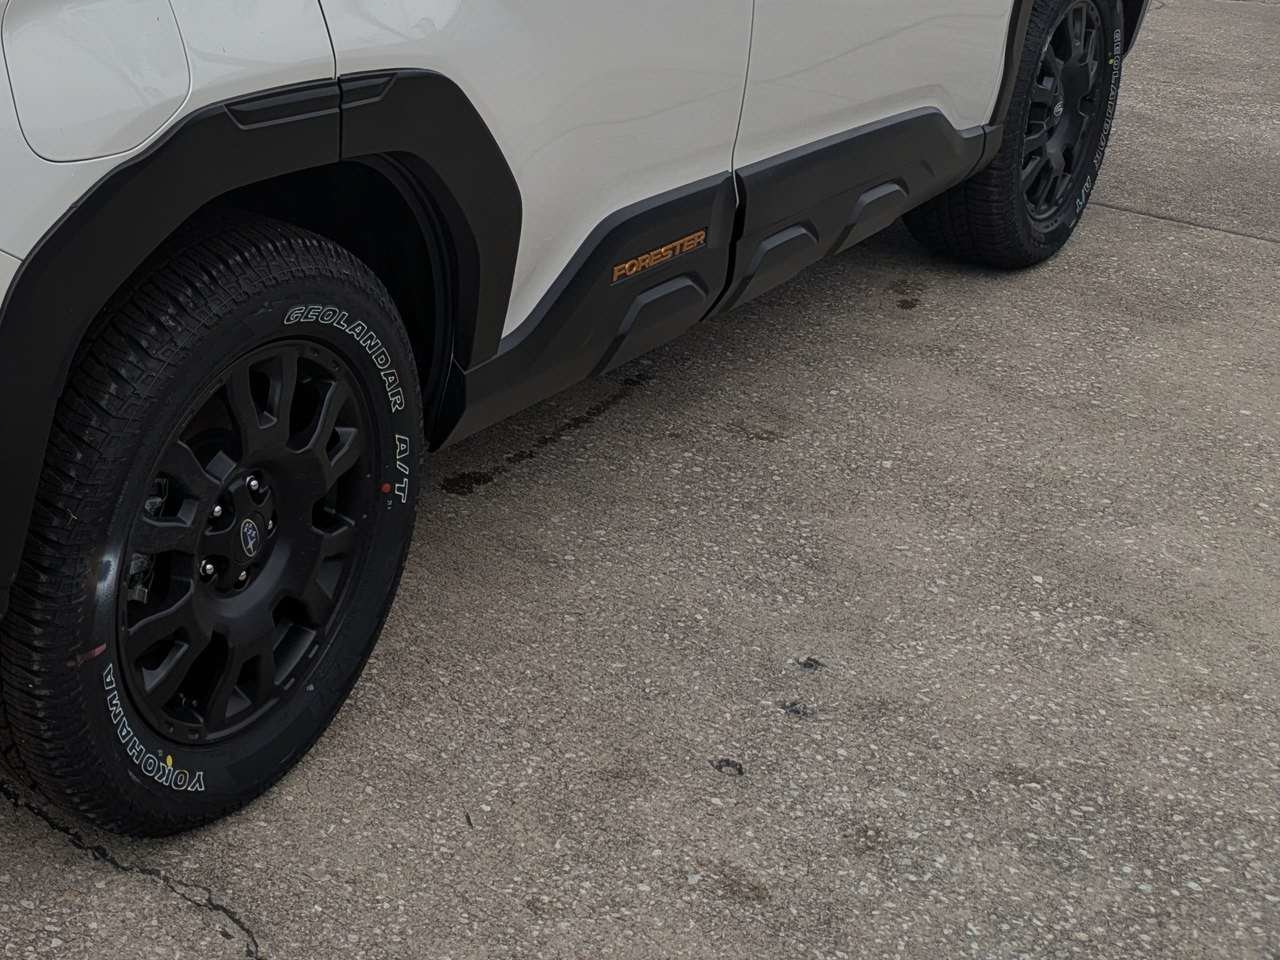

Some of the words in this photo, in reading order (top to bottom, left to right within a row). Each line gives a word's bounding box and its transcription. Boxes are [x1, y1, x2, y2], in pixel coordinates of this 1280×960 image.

[611, 229, 706, 283] FORESTER
[284, 305, 405, 414] GEOLANDAR
[394, 434, 410, 504] A/T
[102, 663, 206, 792] YOKOHAMA
